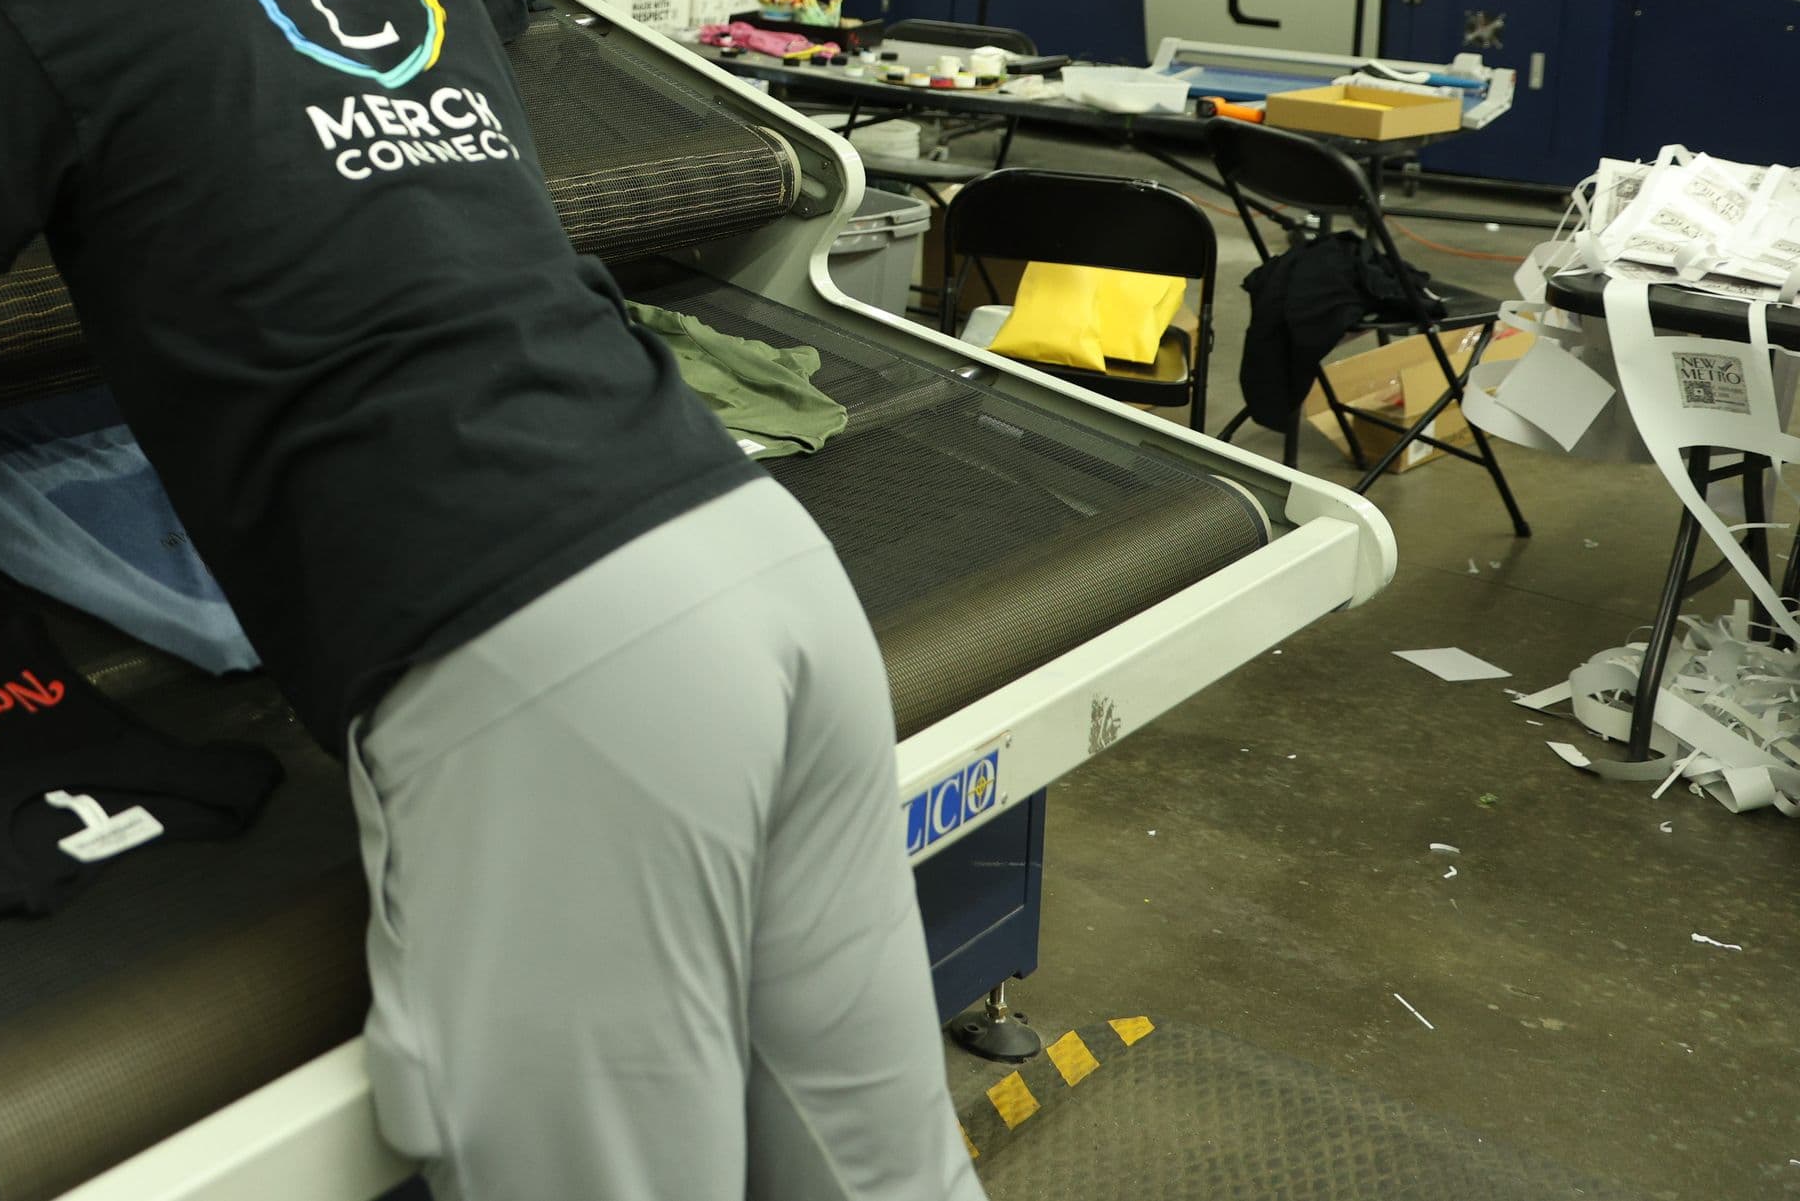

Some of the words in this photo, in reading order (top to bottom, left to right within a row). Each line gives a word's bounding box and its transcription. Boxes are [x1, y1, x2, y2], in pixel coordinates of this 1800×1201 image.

[305, 87, 502, 150] MERCH
[1681, 357, 1716, 369] NEW
[1681, 368, 1741, 384] METRO
